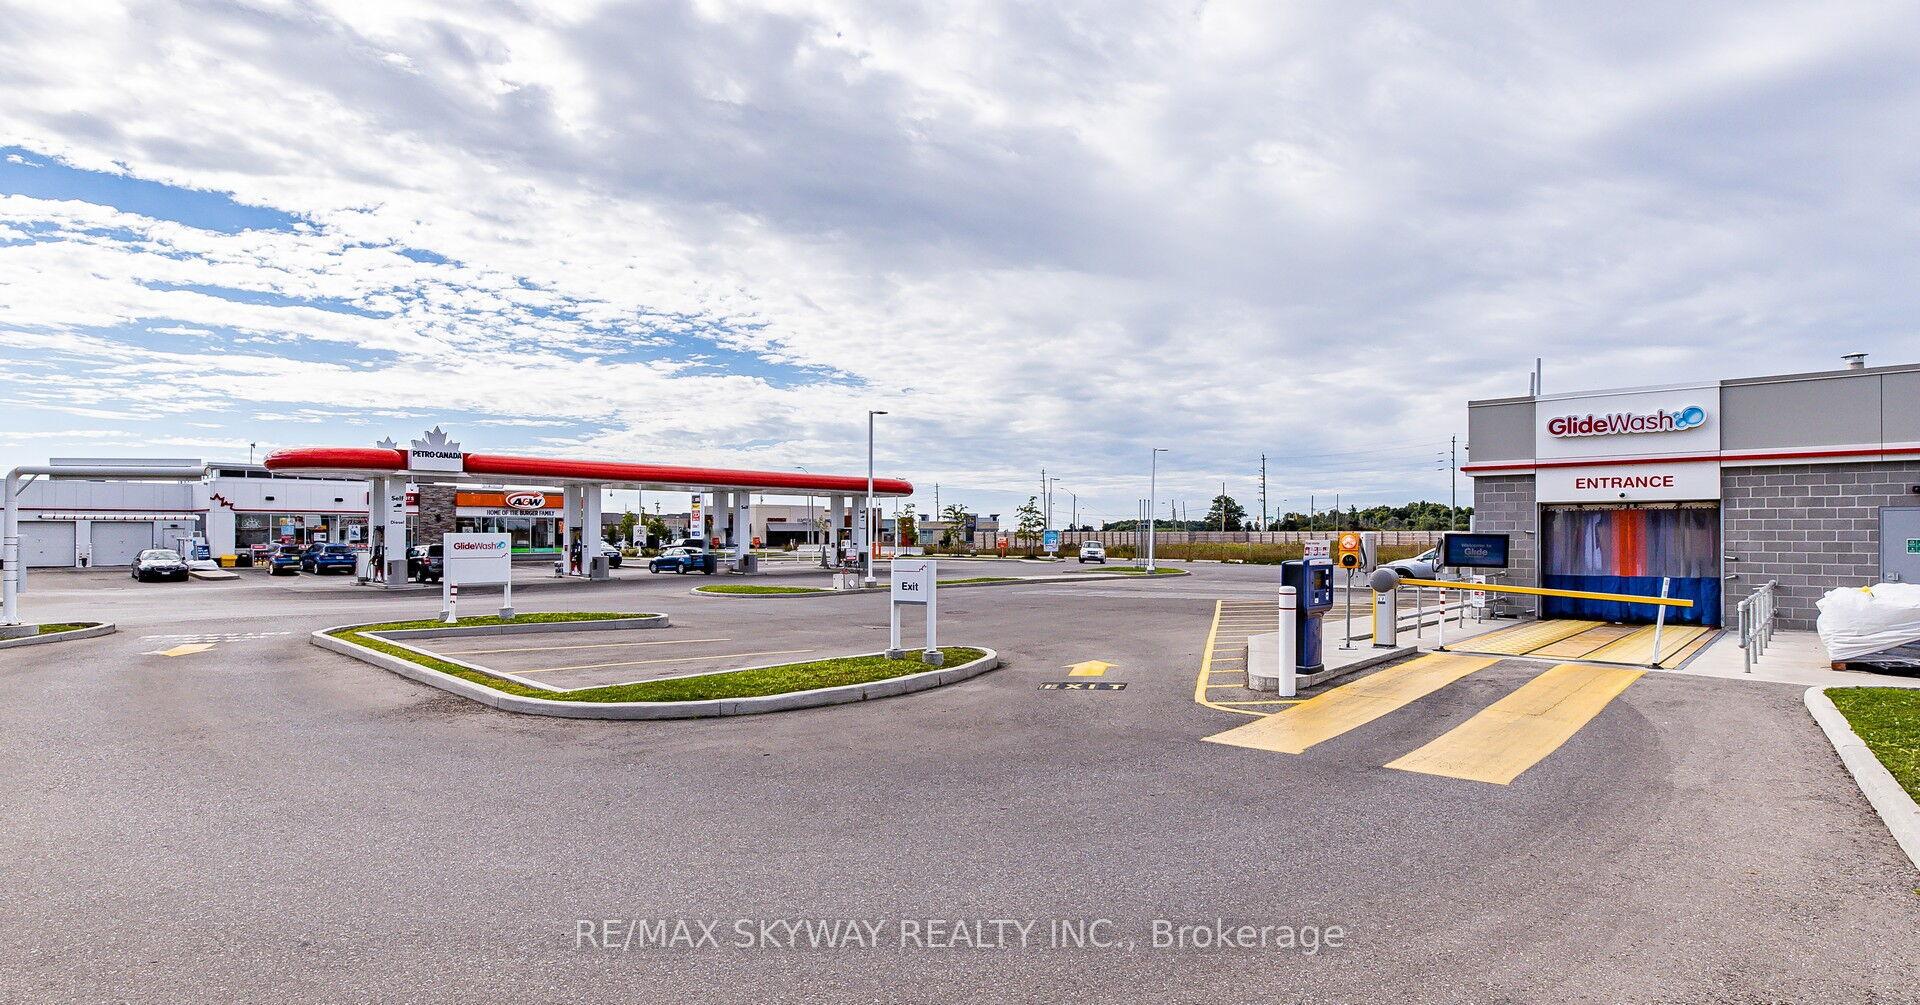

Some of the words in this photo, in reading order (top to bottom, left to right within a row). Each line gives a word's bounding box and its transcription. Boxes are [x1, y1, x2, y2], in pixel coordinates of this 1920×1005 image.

[1548, 410, 1674, 436] GlideWash
[1575, 475, 1674, 489] ENTRANCE
[512, 497, 543, 507] A&W
[454, 542, 496, 550] GlideWash
[1464, 548, 1488, 556] Glide
[902, 582, 919, 591] Exit
